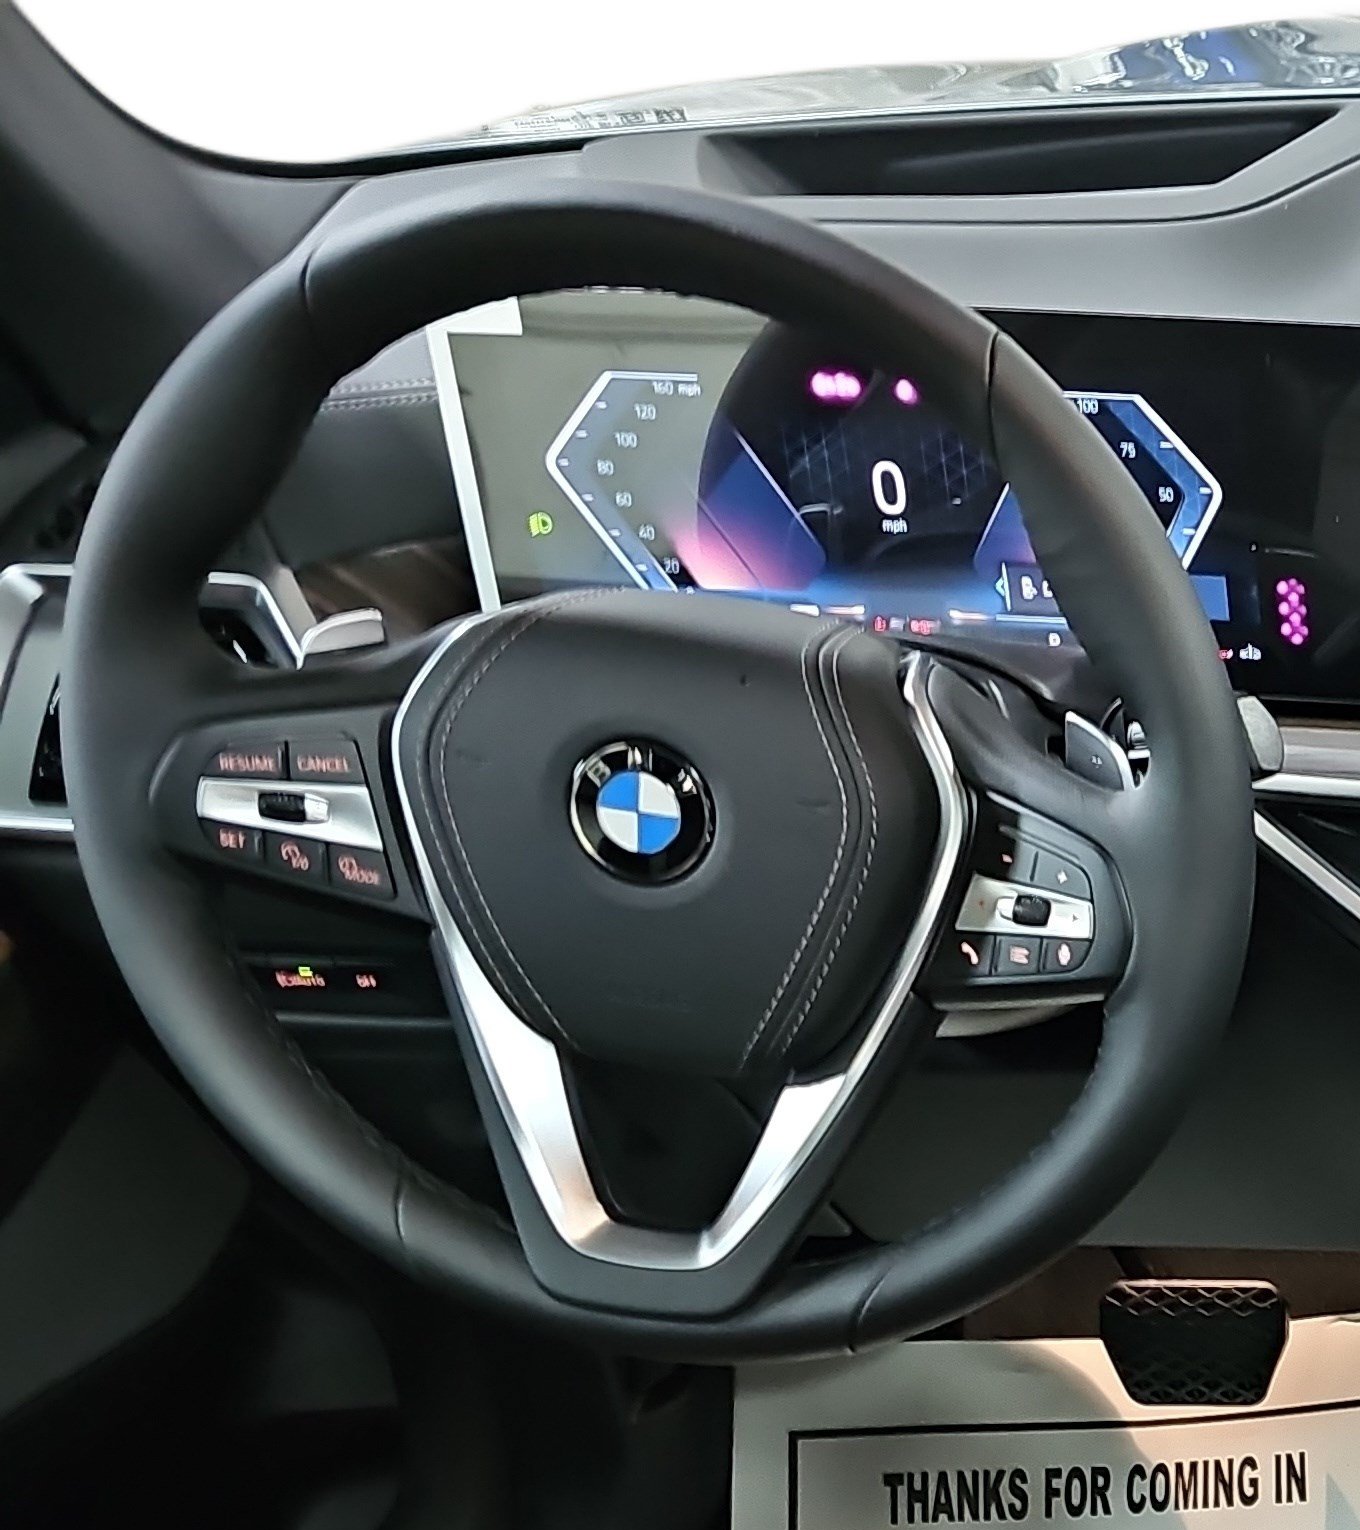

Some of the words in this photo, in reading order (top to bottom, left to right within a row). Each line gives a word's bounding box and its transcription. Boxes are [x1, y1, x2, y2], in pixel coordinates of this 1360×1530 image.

[653, 381, 673, 396] 160
[677, 383, 701, 397] mph
[634, 403, 657, 420] 120
[615, 431, 638, 448] 100
[1119, 441, 1136, 459] 75
[597, 459, 614, 476] 80
[871, 460, 907, 516] 0
[1158, 486, 1175, 503] 50
[615, 491, 633, 508] 60
[639, 523, 656, 541] 40
[881, 517, 908, 534] mph
[663, 557, 680, 575] 20
[219, 753, 276, 773] RESUME
[297, 755, 350, 774] CANCEL
[883, 1468, 1029, 1526] THANKS
[1043, 1465, 1112, 1520] FOR
[1126, 1456, 1260, 1515] COMING
[1274, 1451, 1308, 1505] IN
